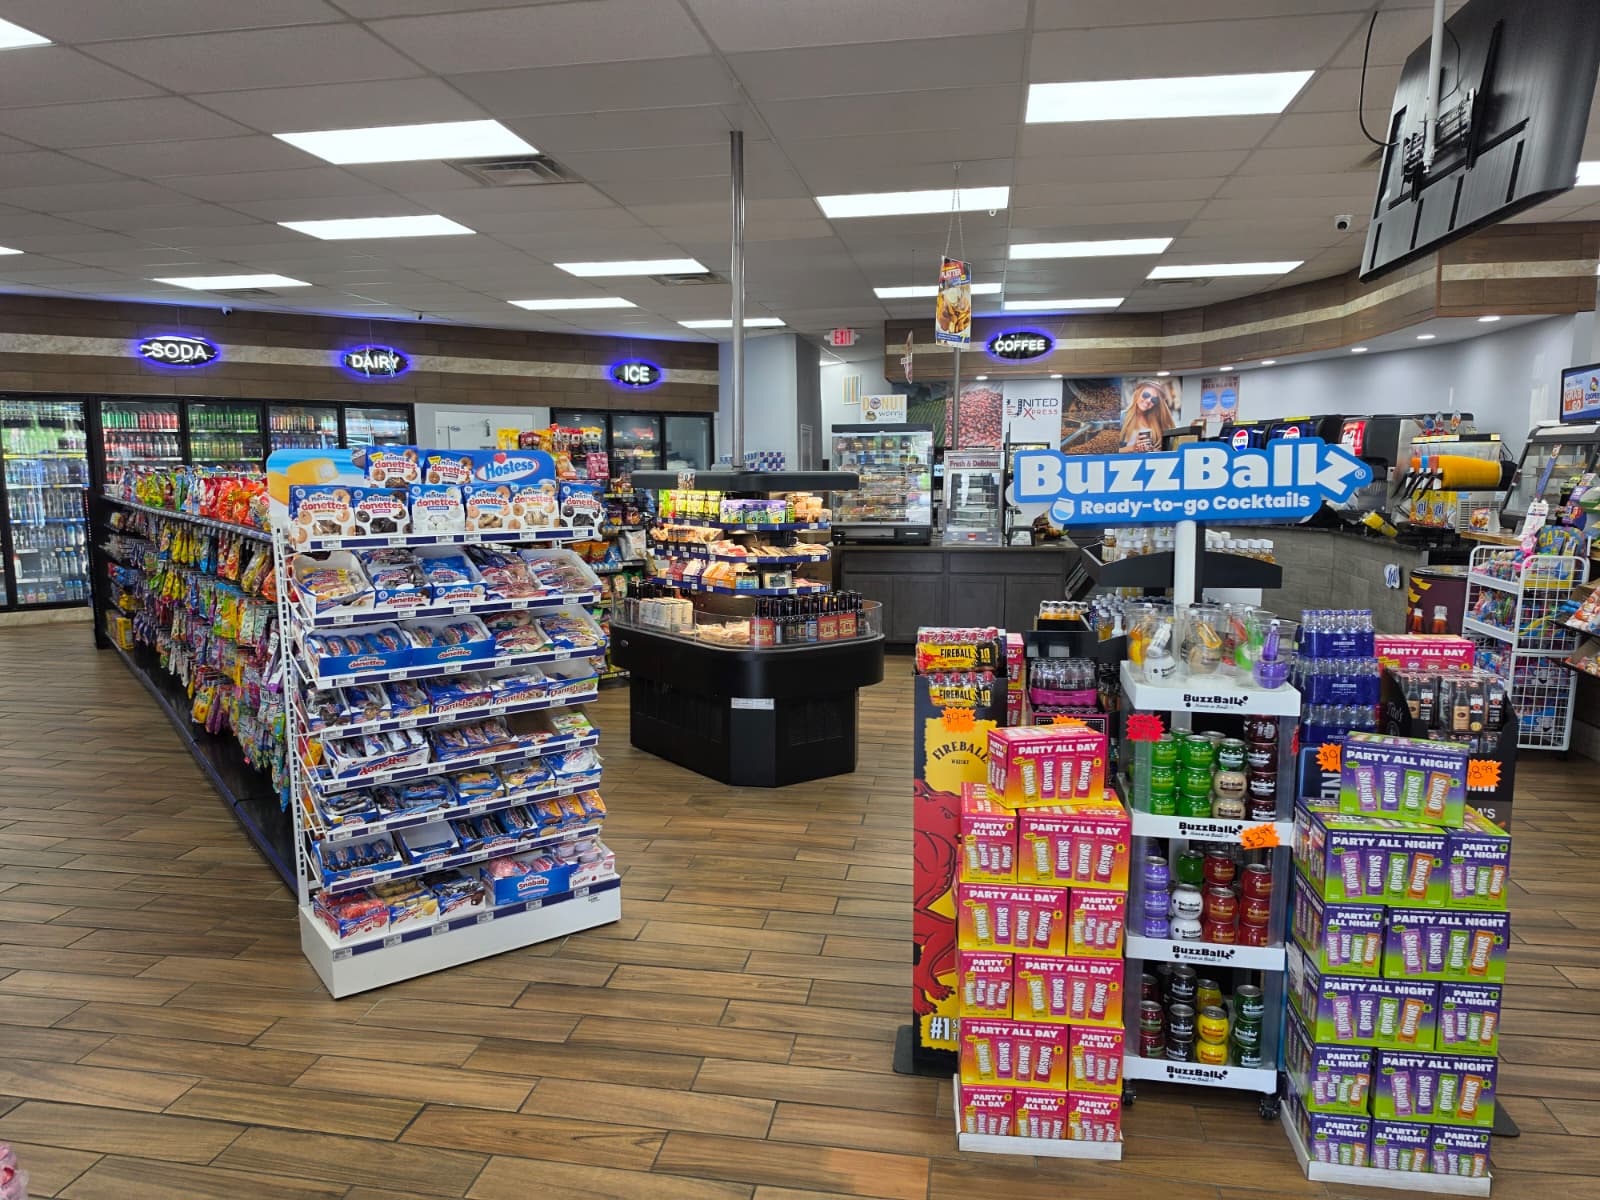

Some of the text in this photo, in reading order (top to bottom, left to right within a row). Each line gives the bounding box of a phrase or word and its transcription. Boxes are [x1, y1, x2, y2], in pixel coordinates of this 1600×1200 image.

[833, 329, 851, 344] EXIT
[994, 339, 1046, 352] COFFEE
[151, 342, 208, 360] SODA
[351, 353, 400, 369] DAIRY
[624, 365, 650, 382] ICE
[484, 459, 534, 480] Hostess
[1081, 491, 1310, 517] Ready-to-go Cocktails
[940, 648, 972, 658] FIREBALL
[1382, 647, 1466, 657] PARTY ALL DAY
[939, 689, 972, 701] FIREBALL
[932, 741, 988, 764] FIREBALL
[1018, 743, 1098, 755] PARTY ALL DAY
[1346, 751, 1463, 770] PARTY ALL NIGHT
[973, 822, 1004, 830] PARTY
[1030, 823, 1120, 835] PARTY ALL DAY
[989, 829, 1007, 837] DAY
[1332, 836, 1445, 850] PARTY ALL NIGHT
[1462, 843, 1498, 851] PARTY
[1452, 849, 1507, 859] ALL NIGHT
[969, 890, 1057, 903] PARTY ALL DAY
[1082, 896, 1114, 905] PARTY
[1098, 904, 1117, 912] DAY
[1337, 912, 1371, 921] PARTY
[1393, 914, 1506, 928] PARTY ALL NIGHT
[1349, 919, 1380, 928] NIGHT
[973, 959, 1003, 967] PARTY
[970, 965, 987, 973] ALL
[1025, 962, 1114, 975] PARTY ALL DAY
[1324, 981, 1435, 996] PARTY ALL NIGHT
[1453, 989, 1488, 999] PARTY
[1444, 996, 1498, 1006] ALL NIGHT
[930, 1016, 950, 1040] #1
[971, 1025, 1058, 1038] PARTY ALL DAY
[1081, 1033, 1113, 1042] PARTY
[1097, 1041, 1116, 1049] DAY
[1326, 1053, 1360, 1061] PARTY
[1318, 1059, 1369, 1068] ALL NIGHT
[1382, 1058, 1494, 1072] PARTY ALL NIGHT
[988, 1100, 1006, 1108] DAY
[1026, 1096, 1057, 1105] PARTY
[1078, 1100, 1109, 1108] PARTY
[1040, 1104, 1060, 1112] DAY
[1075, 1106, 1112, 1115] ALL DAY
[1325, 1121, 1359, 1130] PARTY
[1316, 1127, 1367, 1138] ALL NIGHT
[1385, 1126, 1419, 1136] PARTY
[1444, 1131, 1479, 1141] PARTY
[1376, 1132, 1428, 1143] ALL NIGHT
[1435, 1137, 1487, 1149] ALL NIGHT
